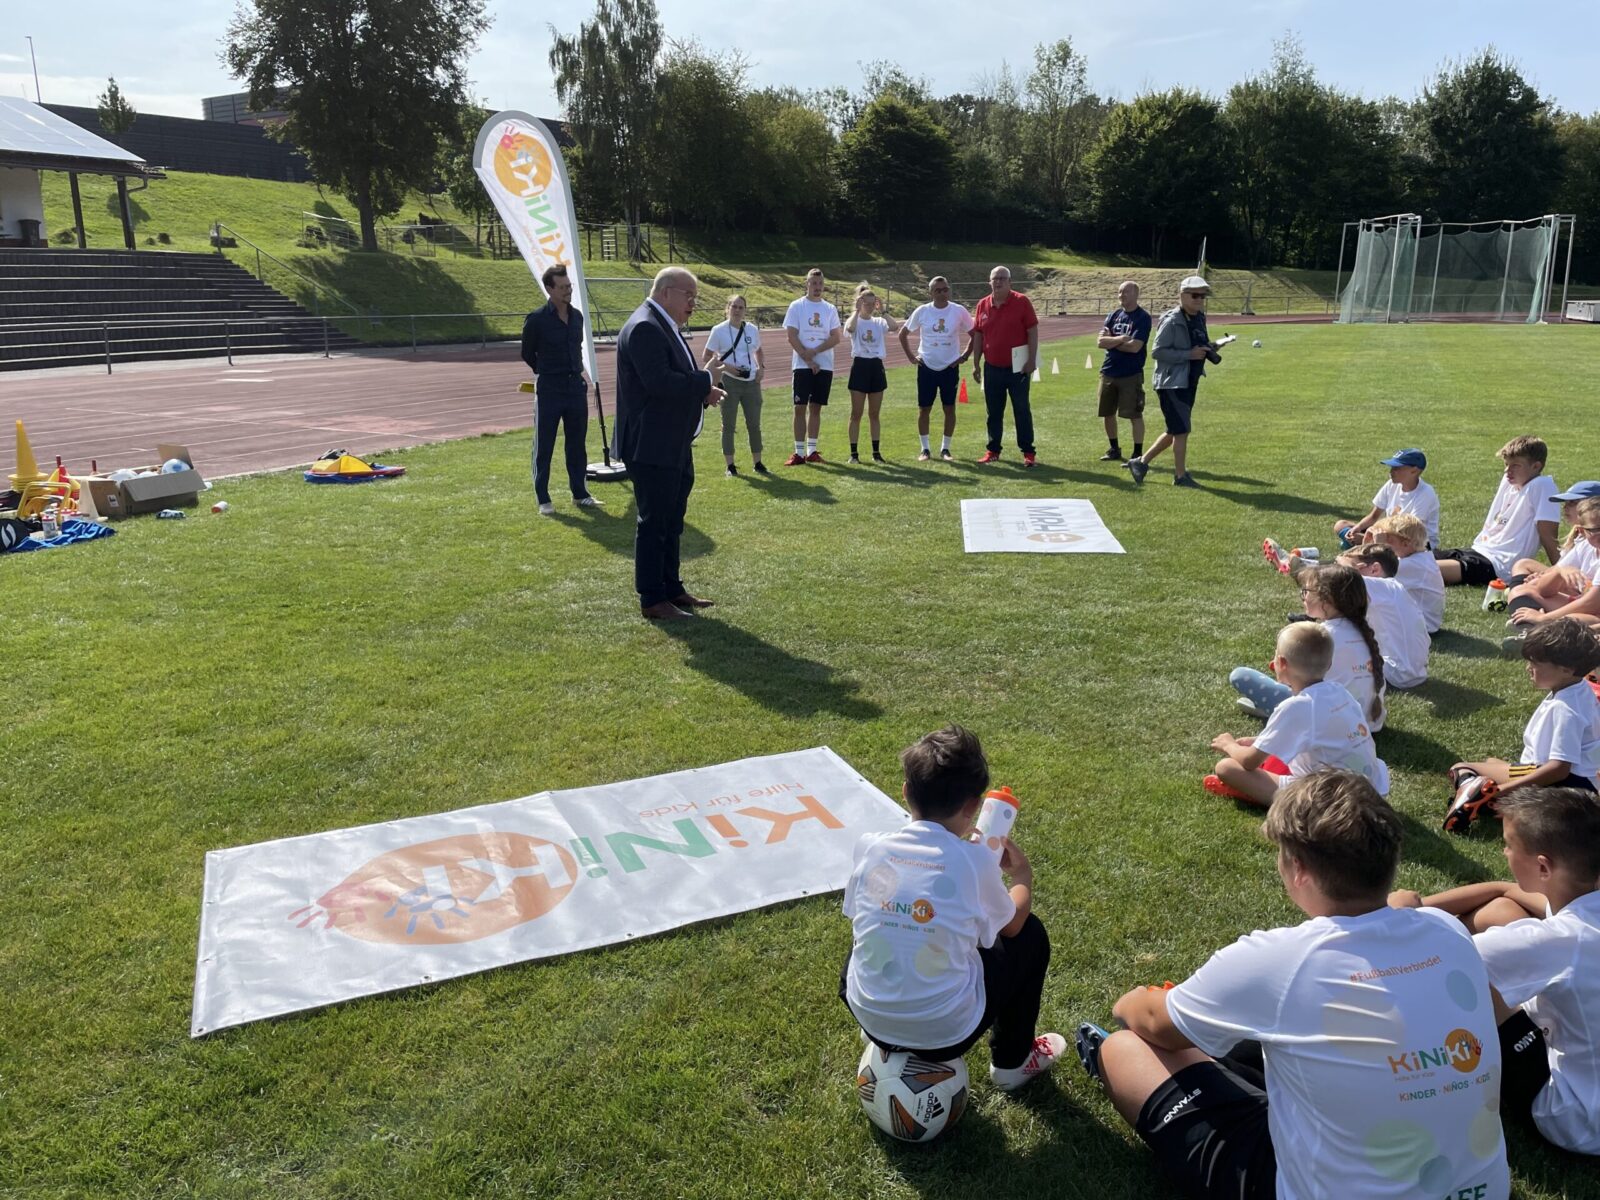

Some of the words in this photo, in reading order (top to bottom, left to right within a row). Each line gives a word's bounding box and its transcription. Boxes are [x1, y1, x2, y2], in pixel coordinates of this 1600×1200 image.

[748, 782, 805, 797] Hilfe
[705, 794, 743, 808] für
[639, 801, 700, 818] Kids
[1387, 1041, 1472, 1075] KiNiKi
